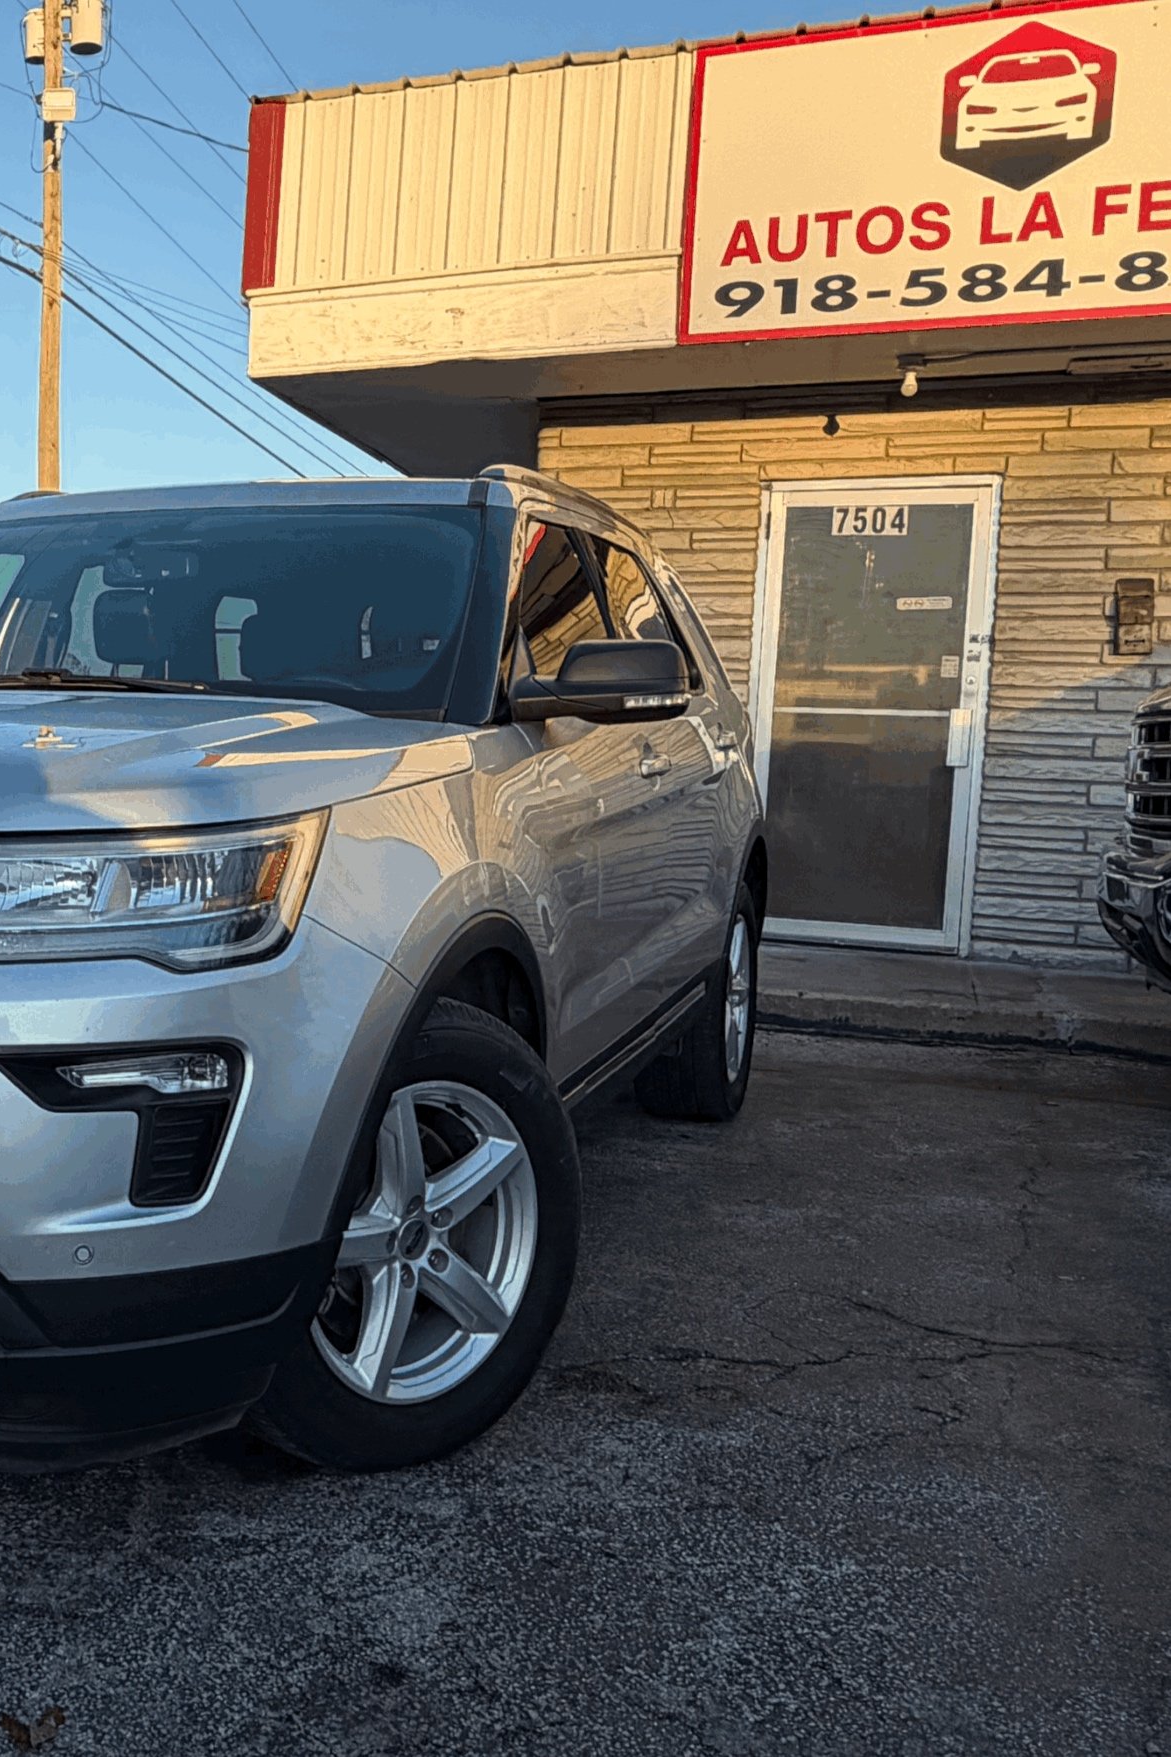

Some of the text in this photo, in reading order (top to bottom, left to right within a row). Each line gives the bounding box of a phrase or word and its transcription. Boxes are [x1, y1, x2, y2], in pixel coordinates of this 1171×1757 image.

[720, 180, 1171, 267] AUTOS LA FE
[714, 251, 1171, 318] 918-584-8
[836, 507, 905, 534] 7504
